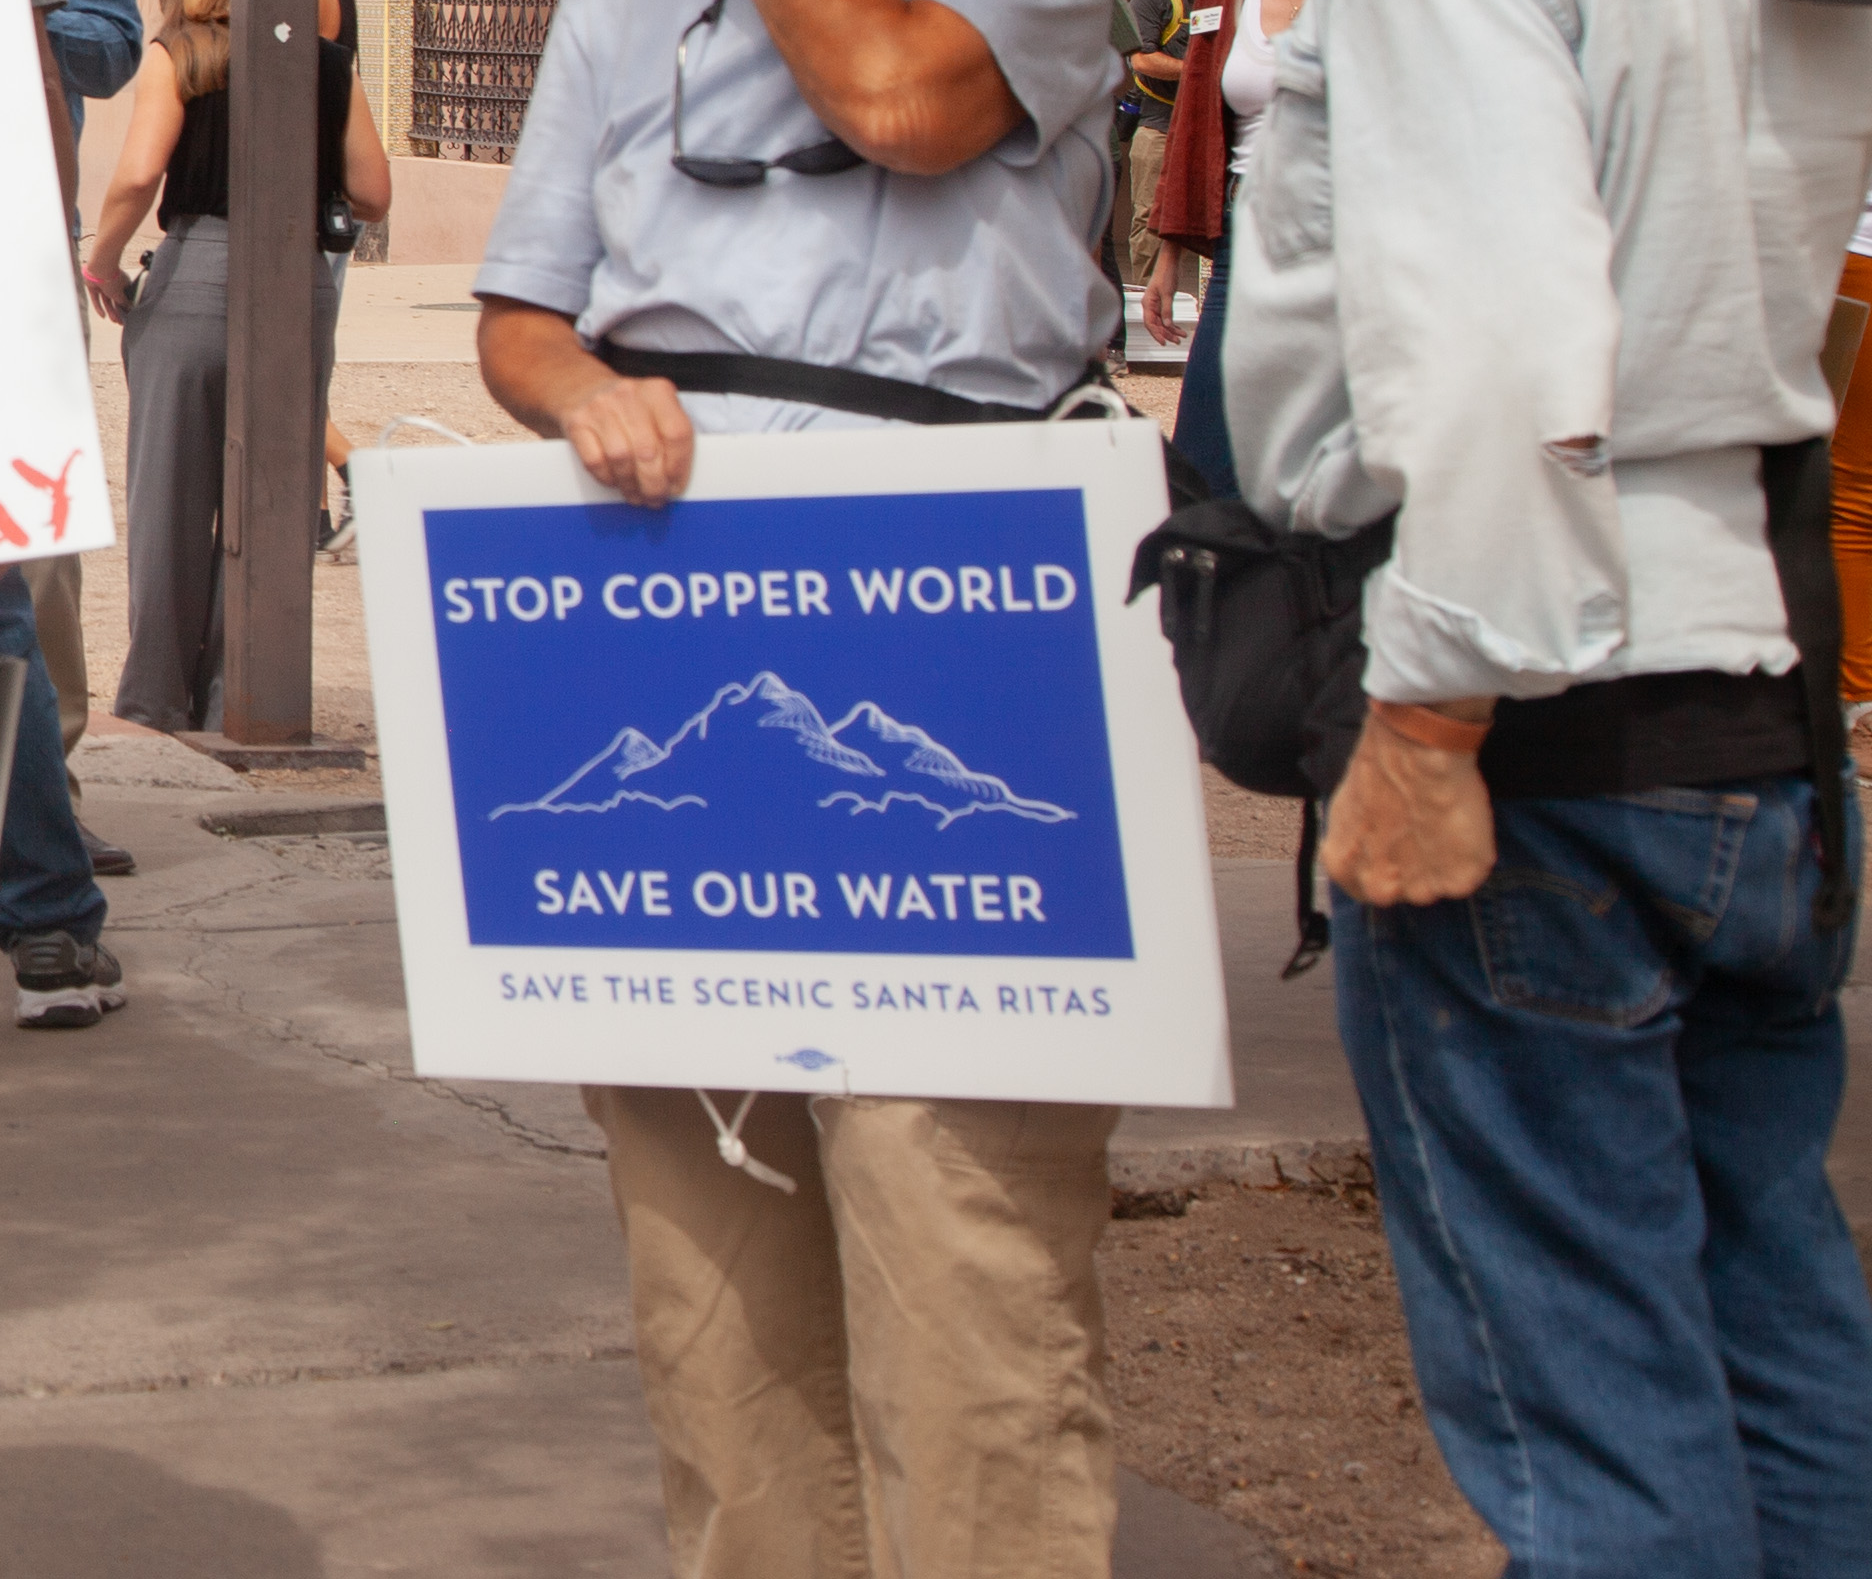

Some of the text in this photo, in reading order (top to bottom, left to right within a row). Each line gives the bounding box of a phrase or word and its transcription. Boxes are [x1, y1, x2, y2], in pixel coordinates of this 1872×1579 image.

[443, 564, 1079, 624] STOP COPPER WORLD
[533, 868, 1048, 924] SAVE OUR WATER
[500, 971, 1113, 1019] SAVE THE SCENIC SANTA RITAS
